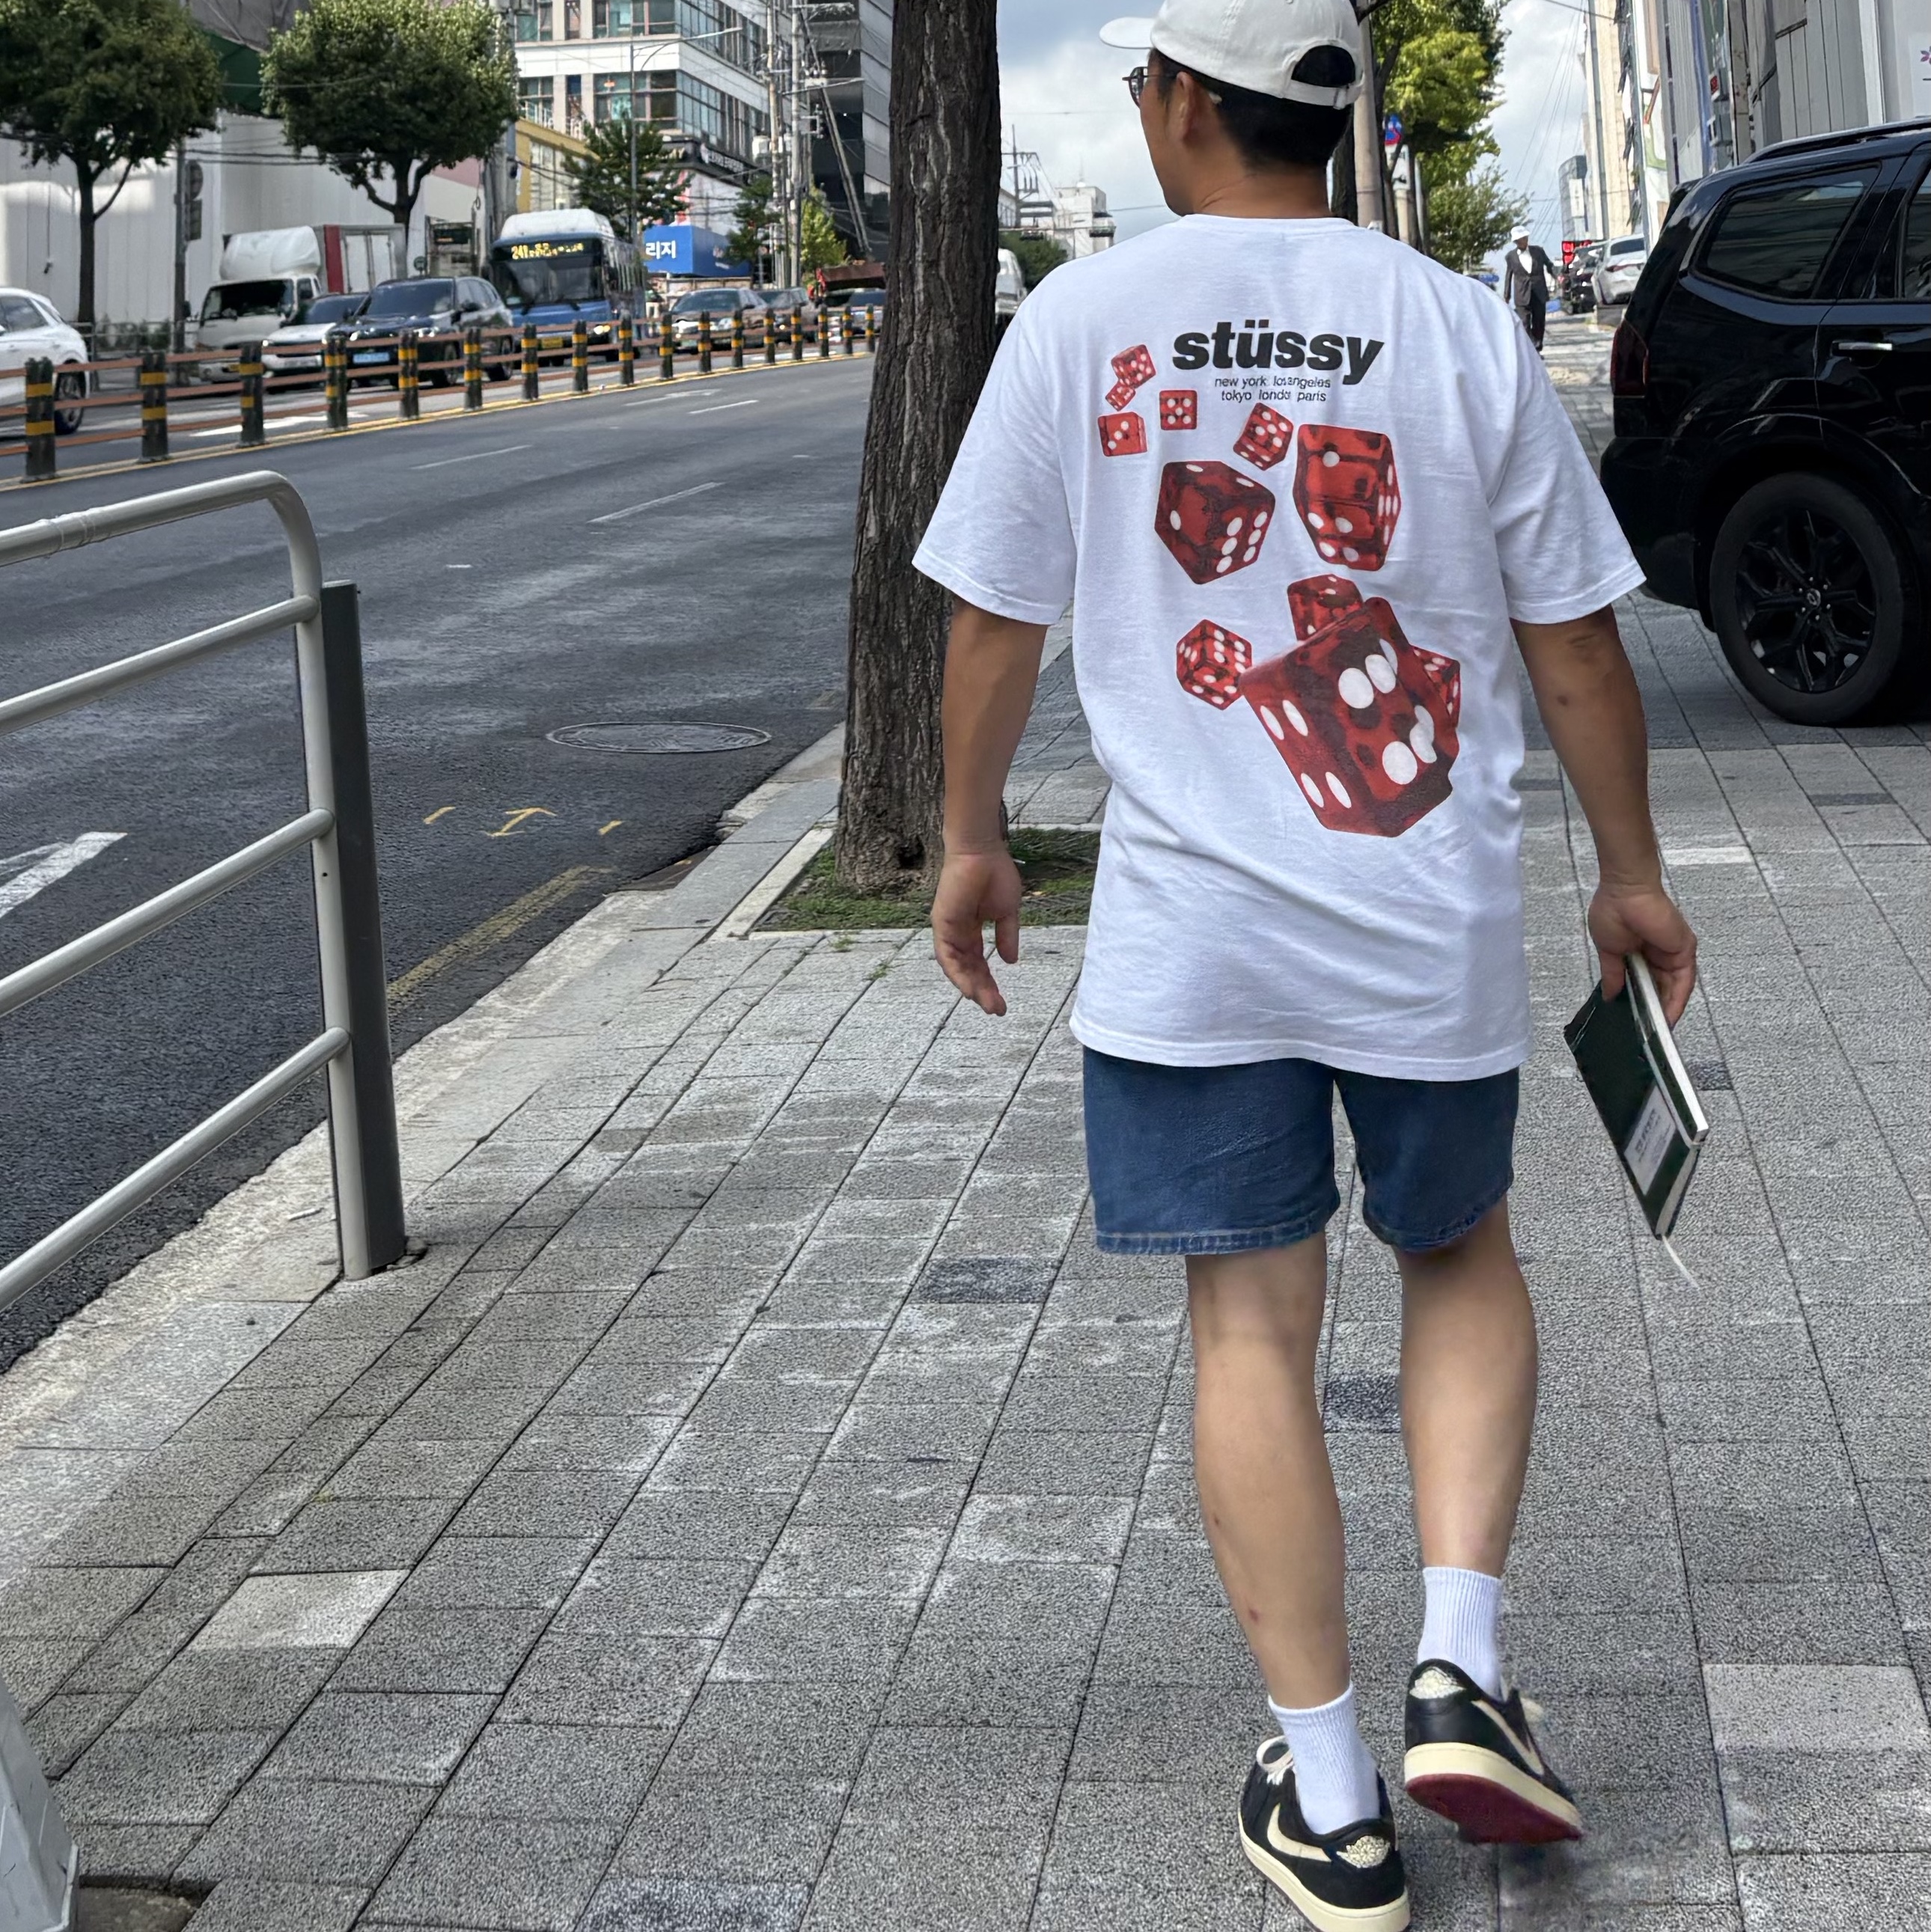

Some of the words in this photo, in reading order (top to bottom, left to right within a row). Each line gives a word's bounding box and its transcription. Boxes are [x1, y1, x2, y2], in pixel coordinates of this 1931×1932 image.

[645, 240, 676, 260] 리지
[1172, 320, 1385, 385] stüssy
[1215, 377, 1239, 387] new
[1241, 376, 1266, 390] york
[1221, 390, 1252, 403] tokyo
[1297, 391, 1327, 403] paris
